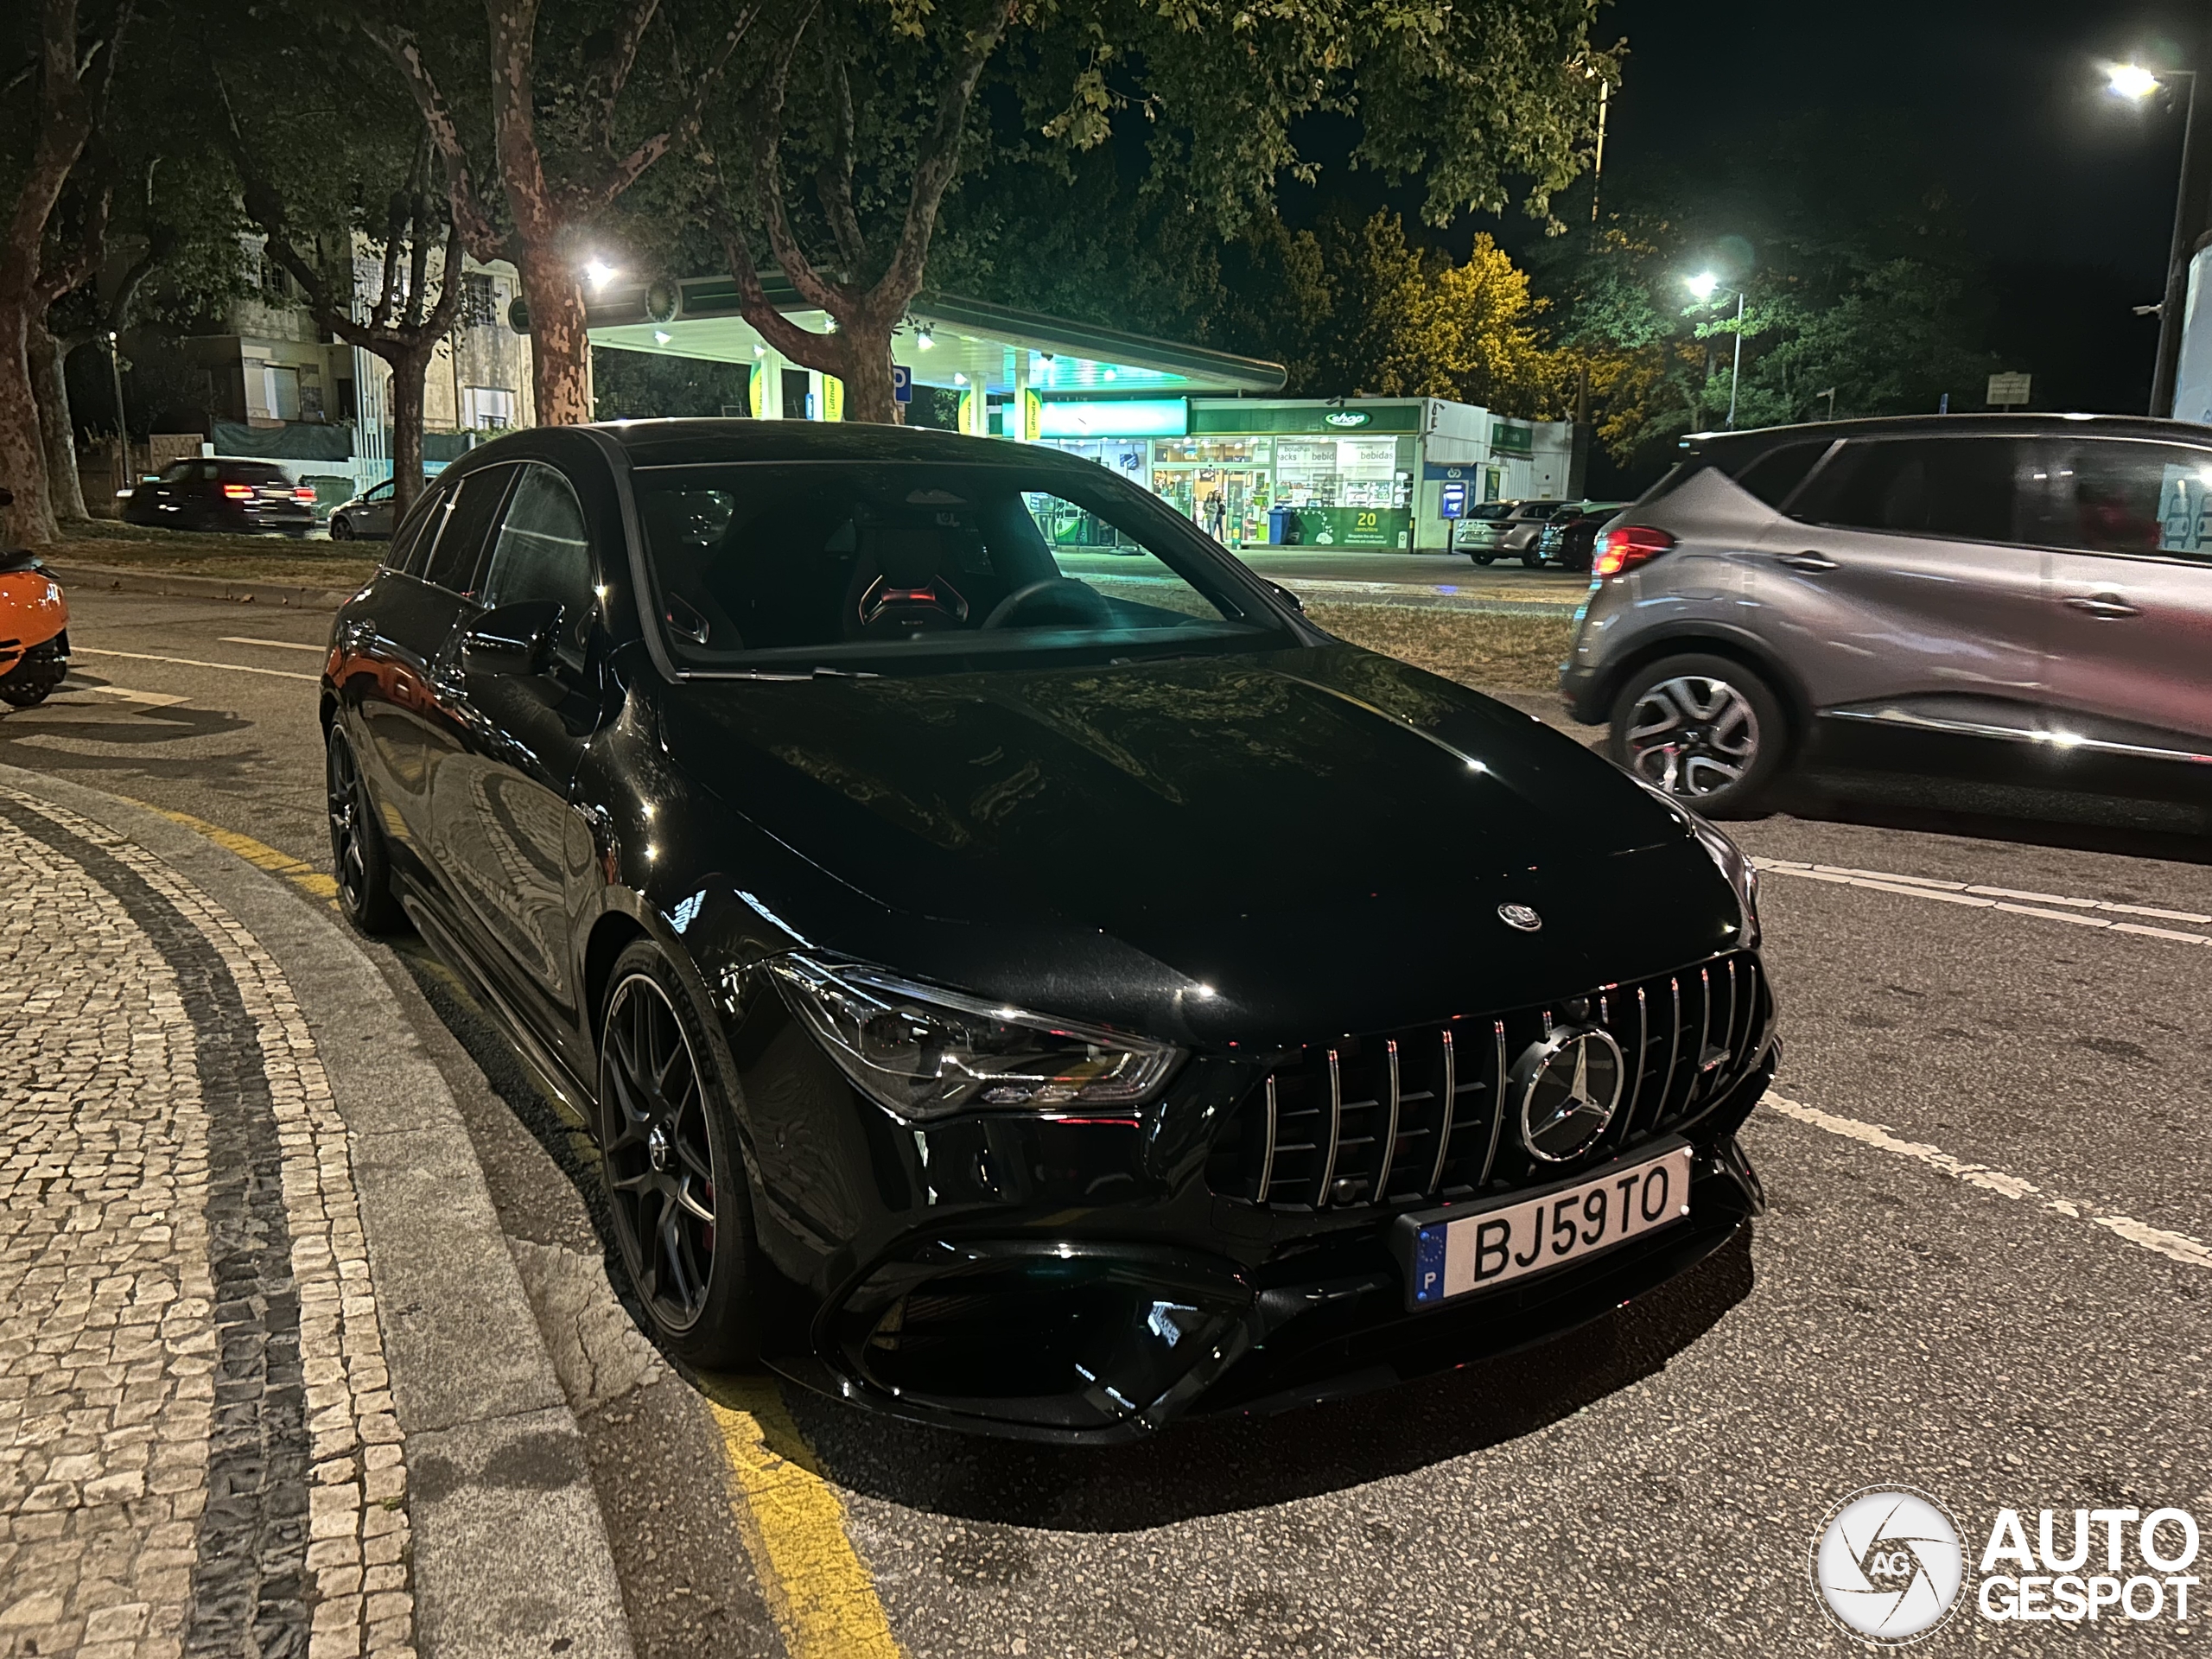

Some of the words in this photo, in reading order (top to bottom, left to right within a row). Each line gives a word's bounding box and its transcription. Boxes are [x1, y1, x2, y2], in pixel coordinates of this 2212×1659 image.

[1329, 412, 1365, 426] shop
[1312, 452, 1336, 461] bebid
[1360, 450, 1394, 460] bebidas
[1357, 512, 1376, 526] 20
[1424, 1272, 1436, 1289] P
